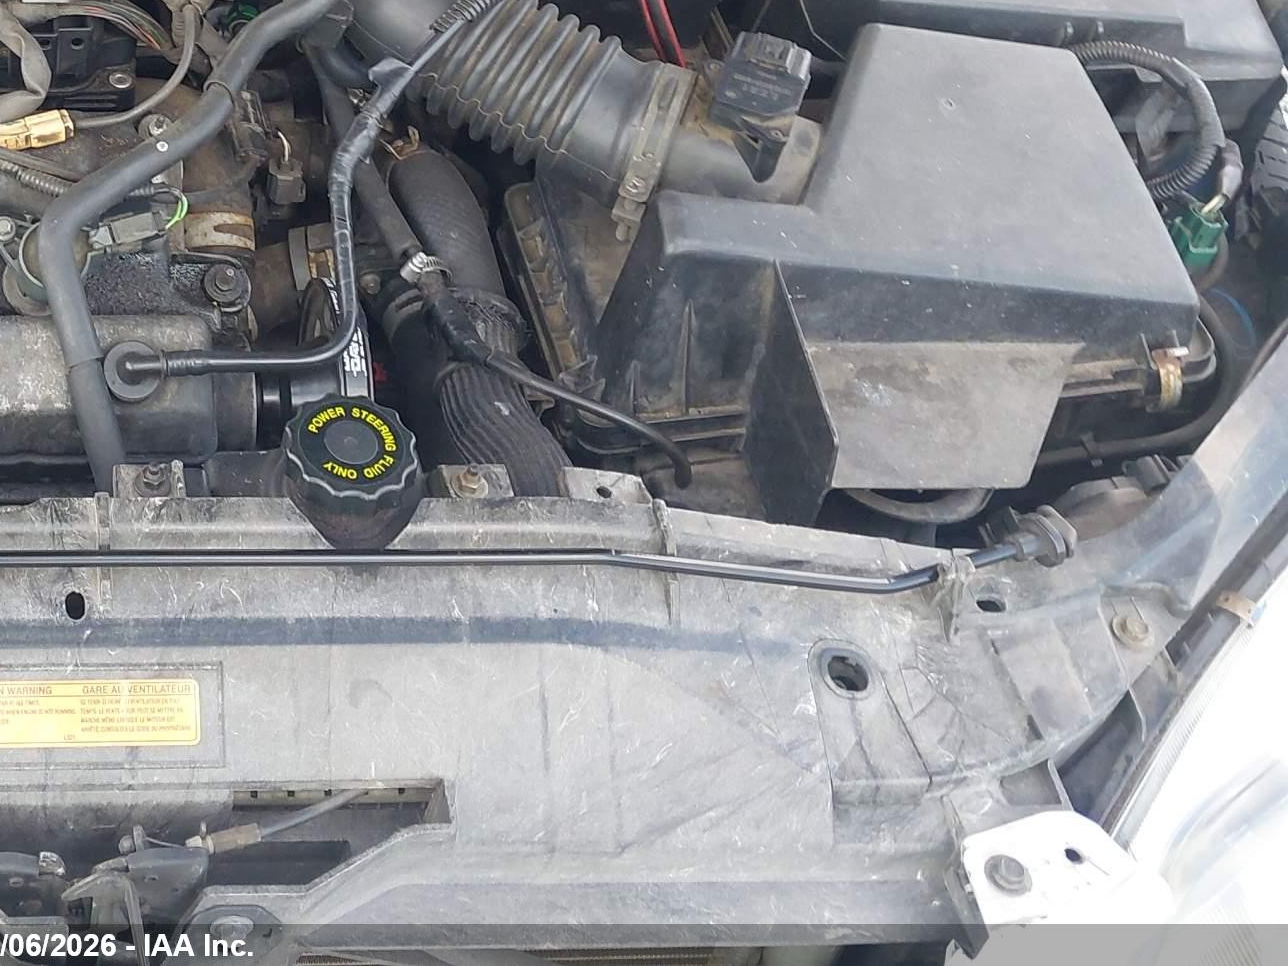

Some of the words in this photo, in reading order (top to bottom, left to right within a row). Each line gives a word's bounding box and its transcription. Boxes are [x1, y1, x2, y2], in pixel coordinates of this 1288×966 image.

[308, 406, 346, 434] POWER
[351, 407, 397, 452] STEERING
[323, 459, 358, 480] ONLY
[363, 454, 394, 479] FLUID
[7, 685, 53, 695] WARNING
[82, 685, 109, 695] GARE
[127, 684, 191, 694] VENTILATEUR
